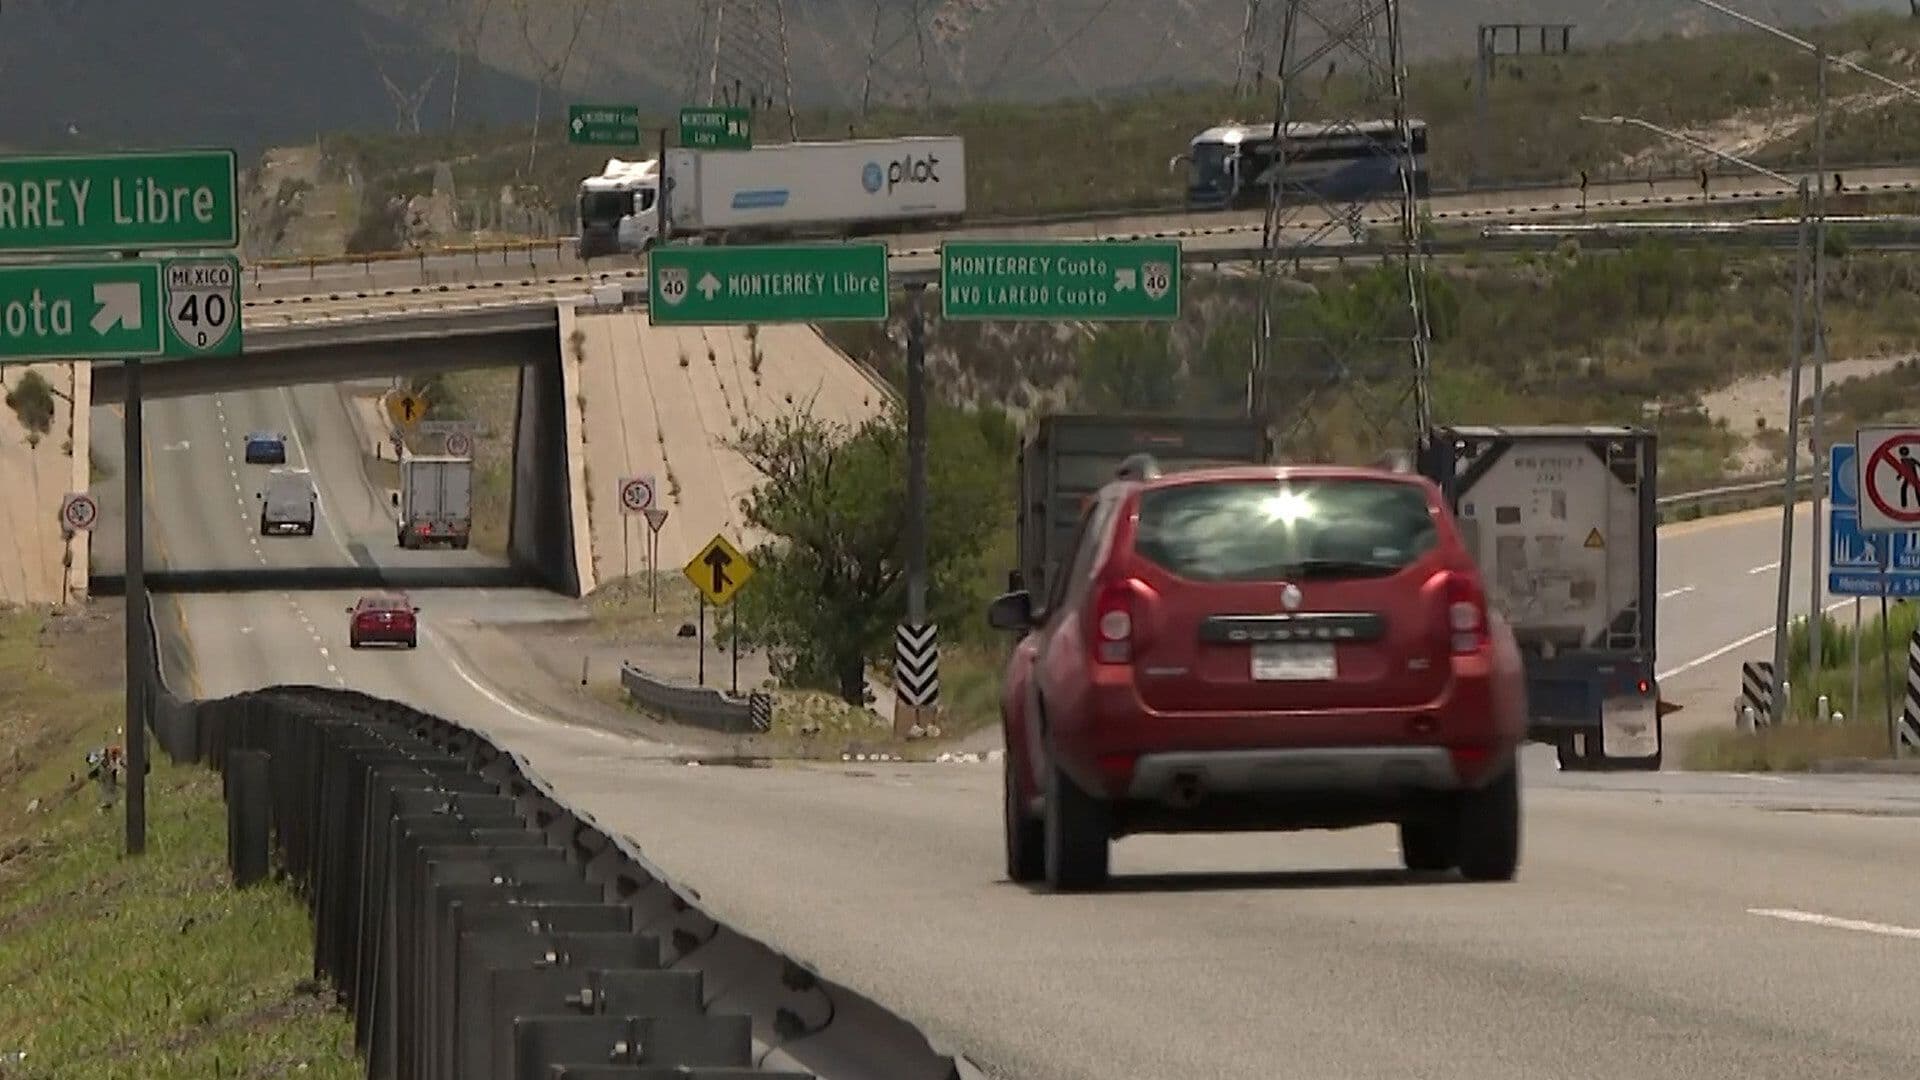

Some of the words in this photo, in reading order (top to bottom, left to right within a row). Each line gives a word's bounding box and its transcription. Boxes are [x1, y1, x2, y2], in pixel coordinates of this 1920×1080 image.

[888, 154, 940, 195] pilot
[112, 177, 214, 225] Libre
[951, 256, 1050, 275] MONTERREY
[172, 268, 229, 285] MEXICO
[728, 271, 825, 296] MONTERREY
[834, 272, 880, 294] Libre
[1147, 275, 1167, 289] 40
[664, 280, 684, 296] 40
[988, 286, 1050, 304] LAREDO
[0, 288, 72, 337] ota
[178, 293, 226, 327] 40
[198, 332, 207, 347] D
